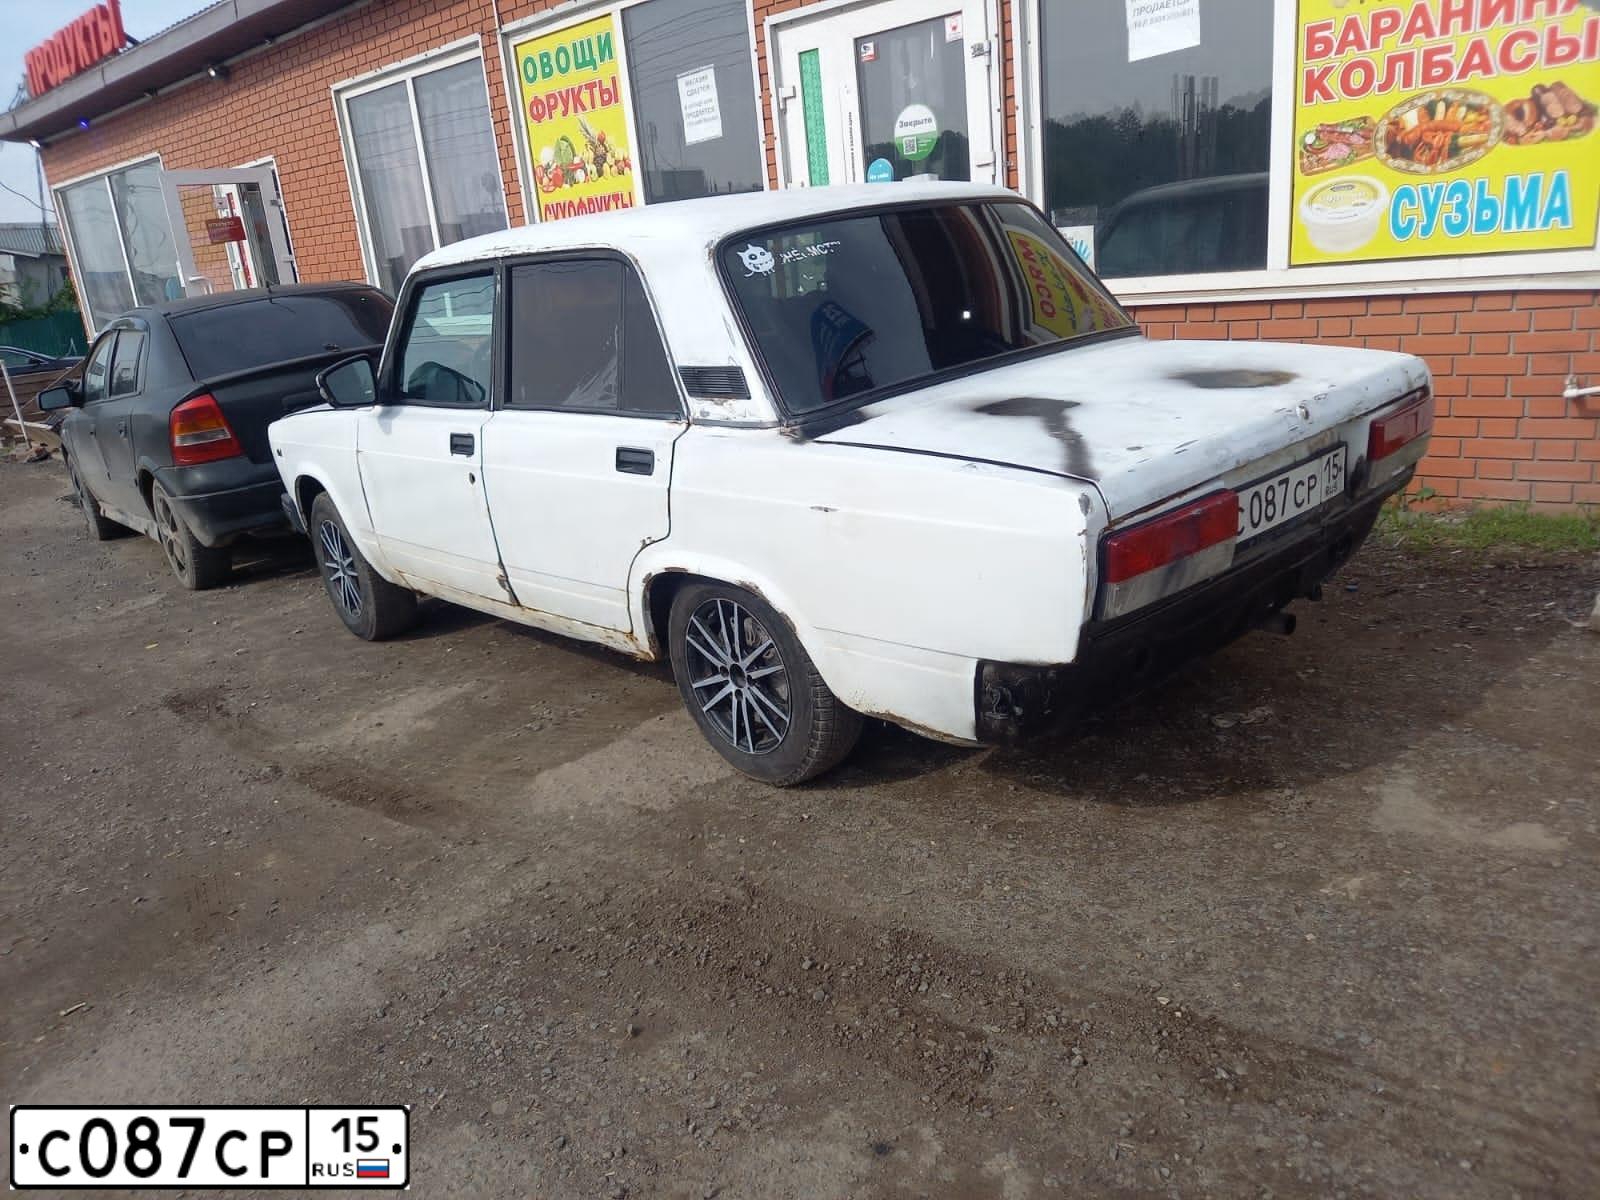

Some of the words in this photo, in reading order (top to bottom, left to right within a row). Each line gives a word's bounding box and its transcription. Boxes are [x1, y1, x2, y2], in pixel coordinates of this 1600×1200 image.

[25, 0, 123, 98] ПРОДУКТЫ
[523, 32, 613, 84] ОВОЩИ
[1304, 0, 1579, 61] БАРАНИН
[1303, 18, 1600, 104] КОЛБАСЫ
[529, 76, 620, 123] ФРУКТЫ
[899, 117, 932, 129] Закрыто
[1390, 170, 1573, 241] СУЗЬМА
[1324, 453, 1340, 483] 15
